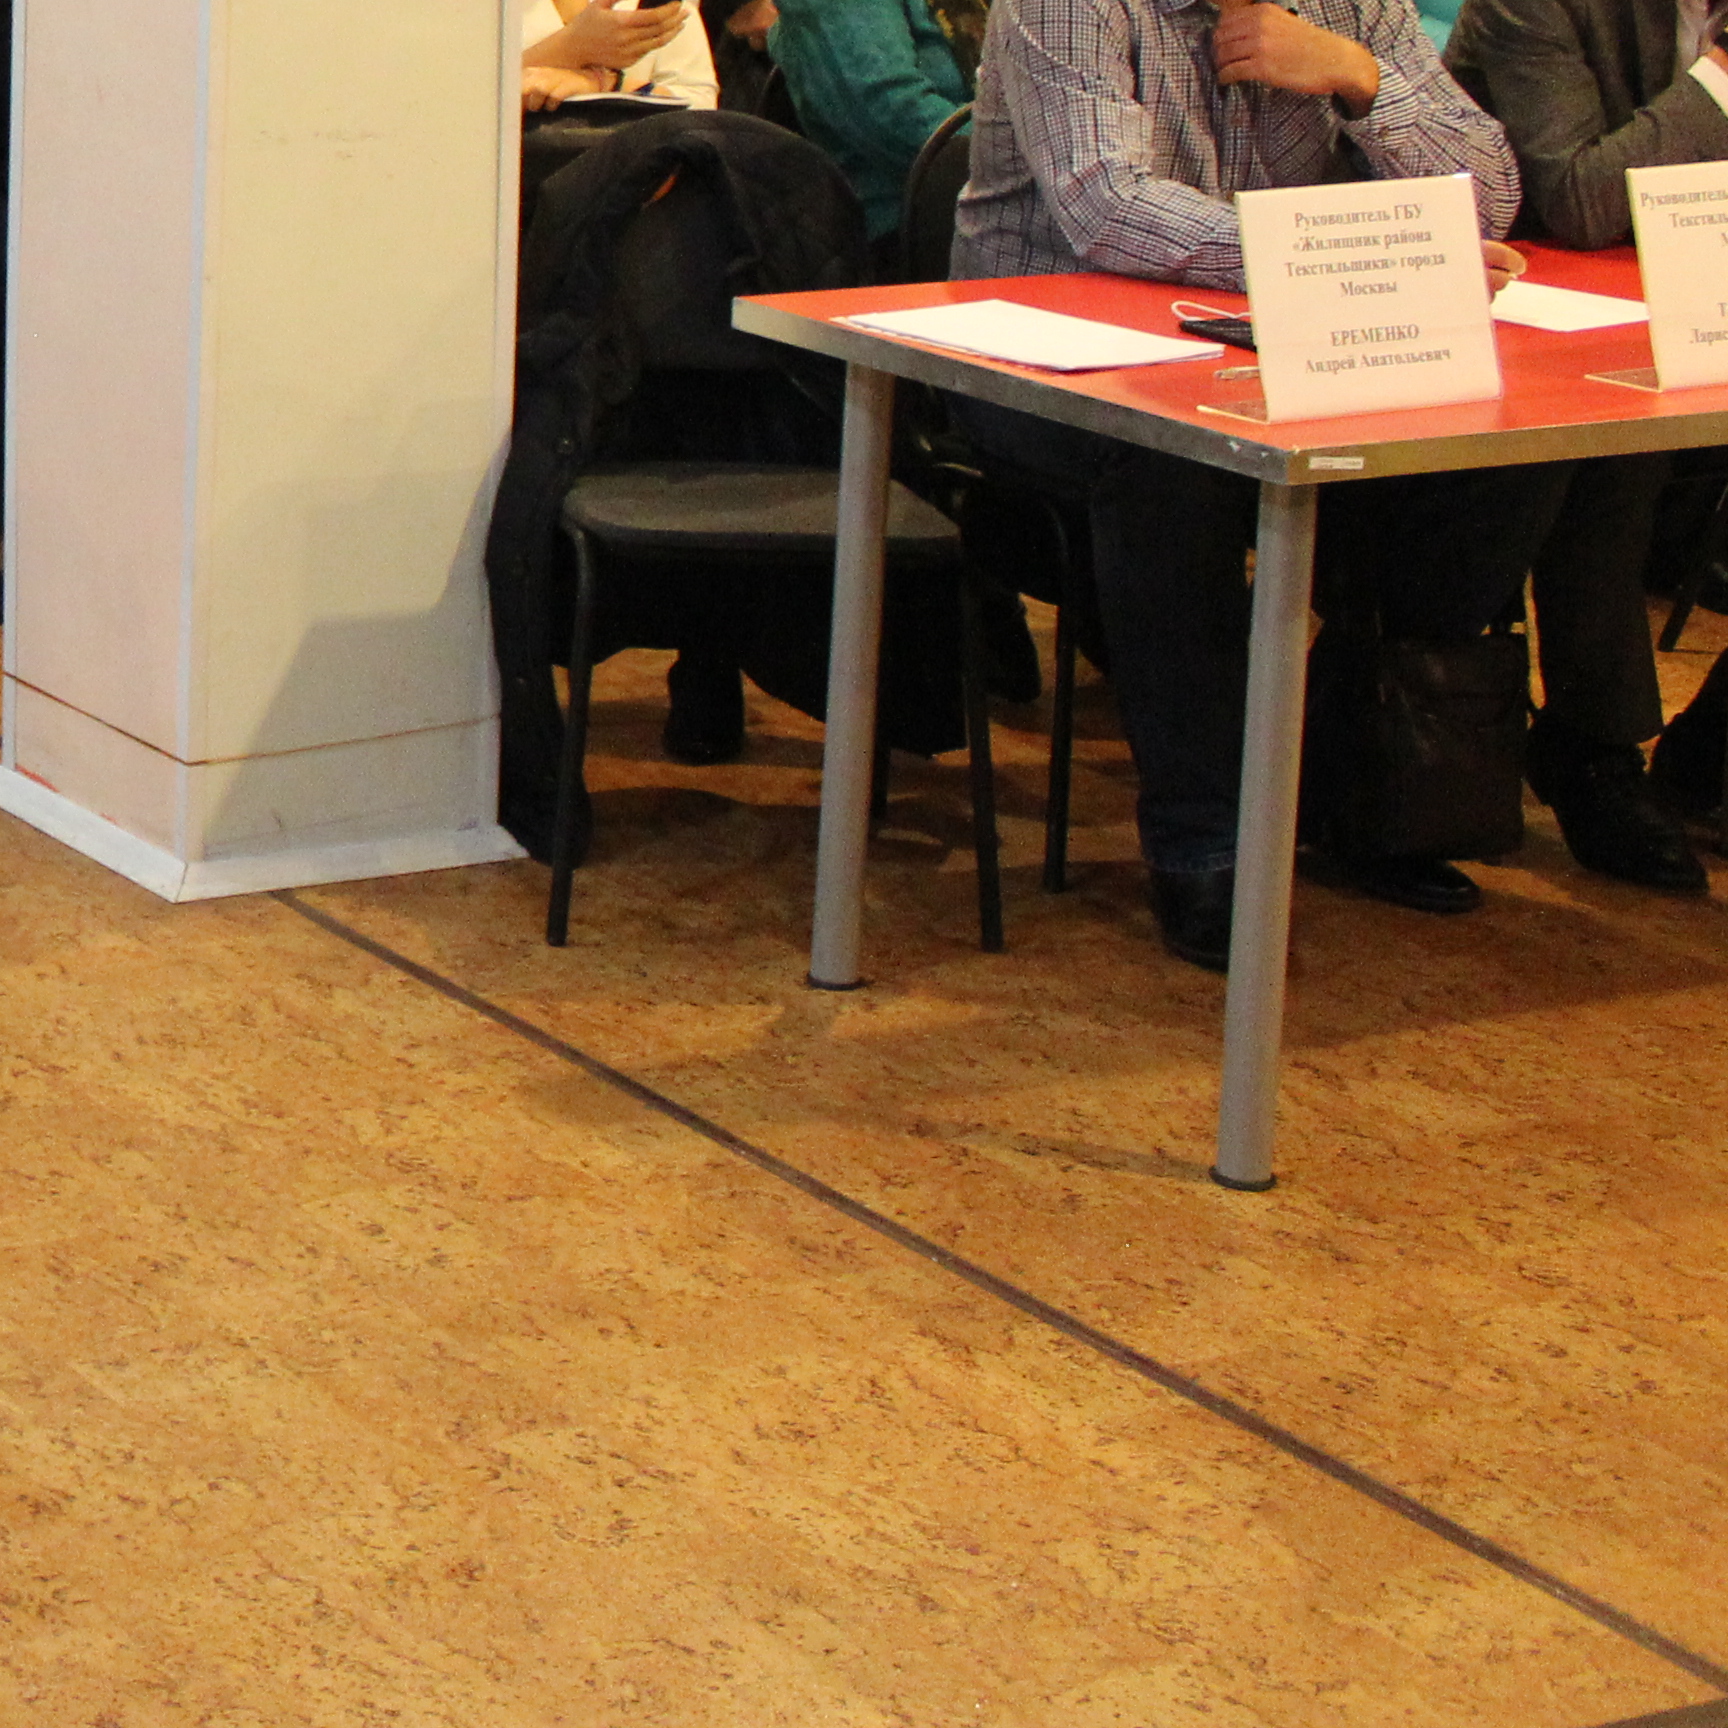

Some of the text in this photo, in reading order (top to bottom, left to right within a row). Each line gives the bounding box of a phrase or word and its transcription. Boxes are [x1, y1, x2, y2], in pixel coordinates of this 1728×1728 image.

[1295, 204, 1423, 231] Руководитель ГБУ
[1384, 229, 1432, 249] района
[1401, 253, 1446, 270] города
[1340, 281, 1397, 297] Москвы
[1331, 324, 1419, 346] ЕРЕМЕНКО
[1306, 349, 1450, 374] Андрей Анатольевич
